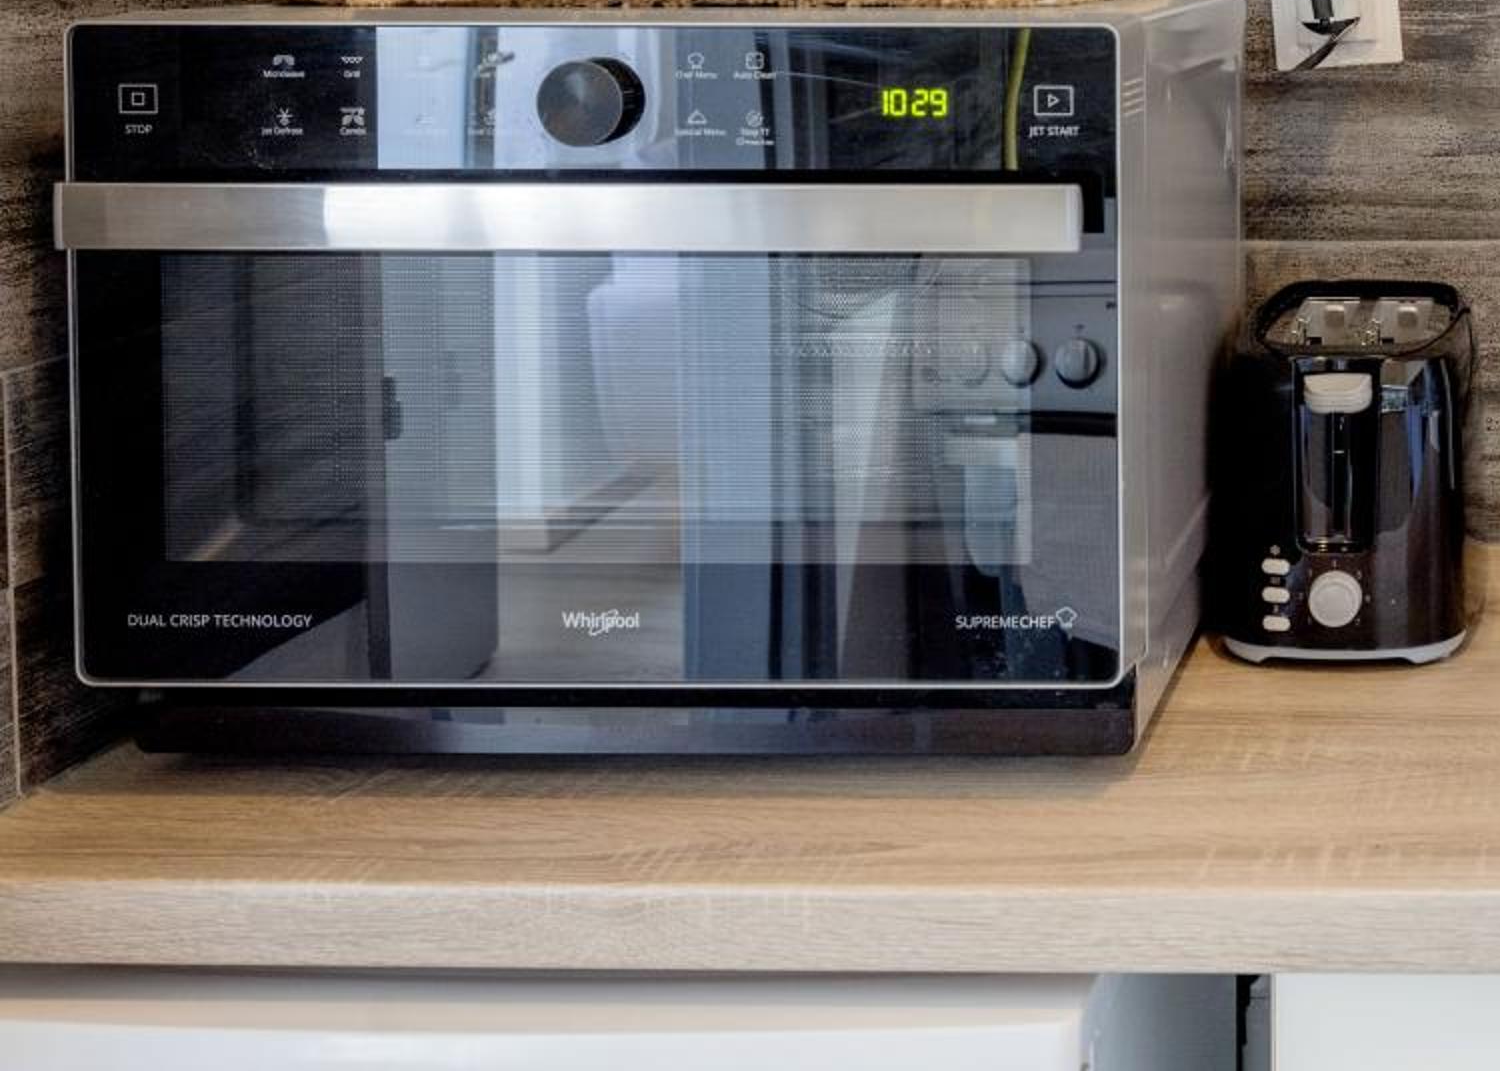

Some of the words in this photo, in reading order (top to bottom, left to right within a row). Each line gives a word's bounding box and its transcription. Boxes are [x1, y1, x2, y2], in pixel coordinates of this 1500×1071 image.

[124, 124, 153, 135] STOP
[1028, 125, 1045, 138] JET
[1047, 125, 1080, 137] START
[127, 613, 167, 628] DUAL
[169, 613, 210, 628] CRISP
[213, 613, 313, 628] TECHNOLOGY
[561, 609, 640, 636] Whirlpool
[954, 614, 1056, 630] SUPREMECHEF
